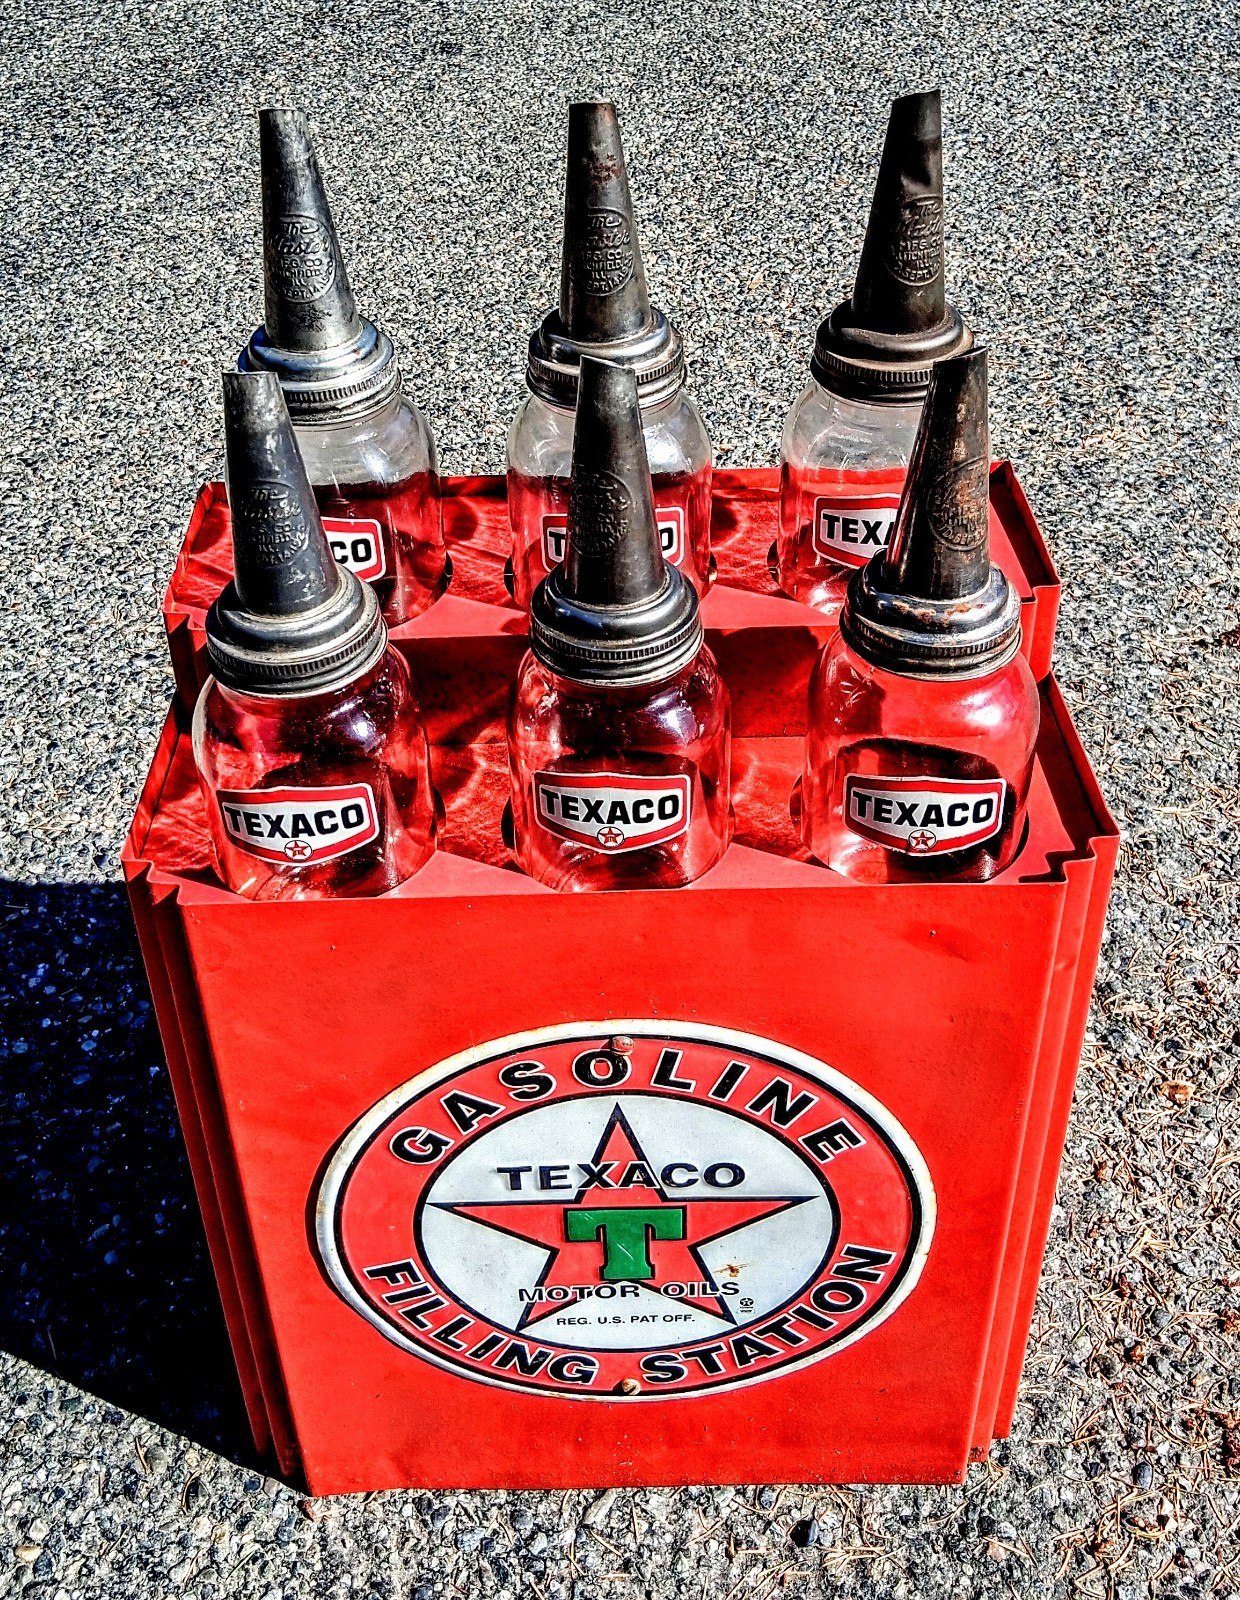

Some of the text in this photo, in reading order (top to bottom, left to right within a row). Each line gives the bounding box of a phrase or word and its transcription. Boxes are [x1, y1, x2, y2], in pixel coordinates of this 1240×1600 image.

[224, 803, 364, 839] TEXACO
[539, 788, 681, 825] TEXACO
[852, 790, 994, 828] TEXACO
[389, 1048, 868, 1166] GASOLINE
[497, 1162, 746, 1192] TEXACO
[564, 1205, 687, 1280] T
[519, 1280, 741, 1303] MOTOR OILS
[362, 1242, 898, 1387] FILLING STATION
[556, 1313, 696, 1326] REG. U.S. PAT OFF.
